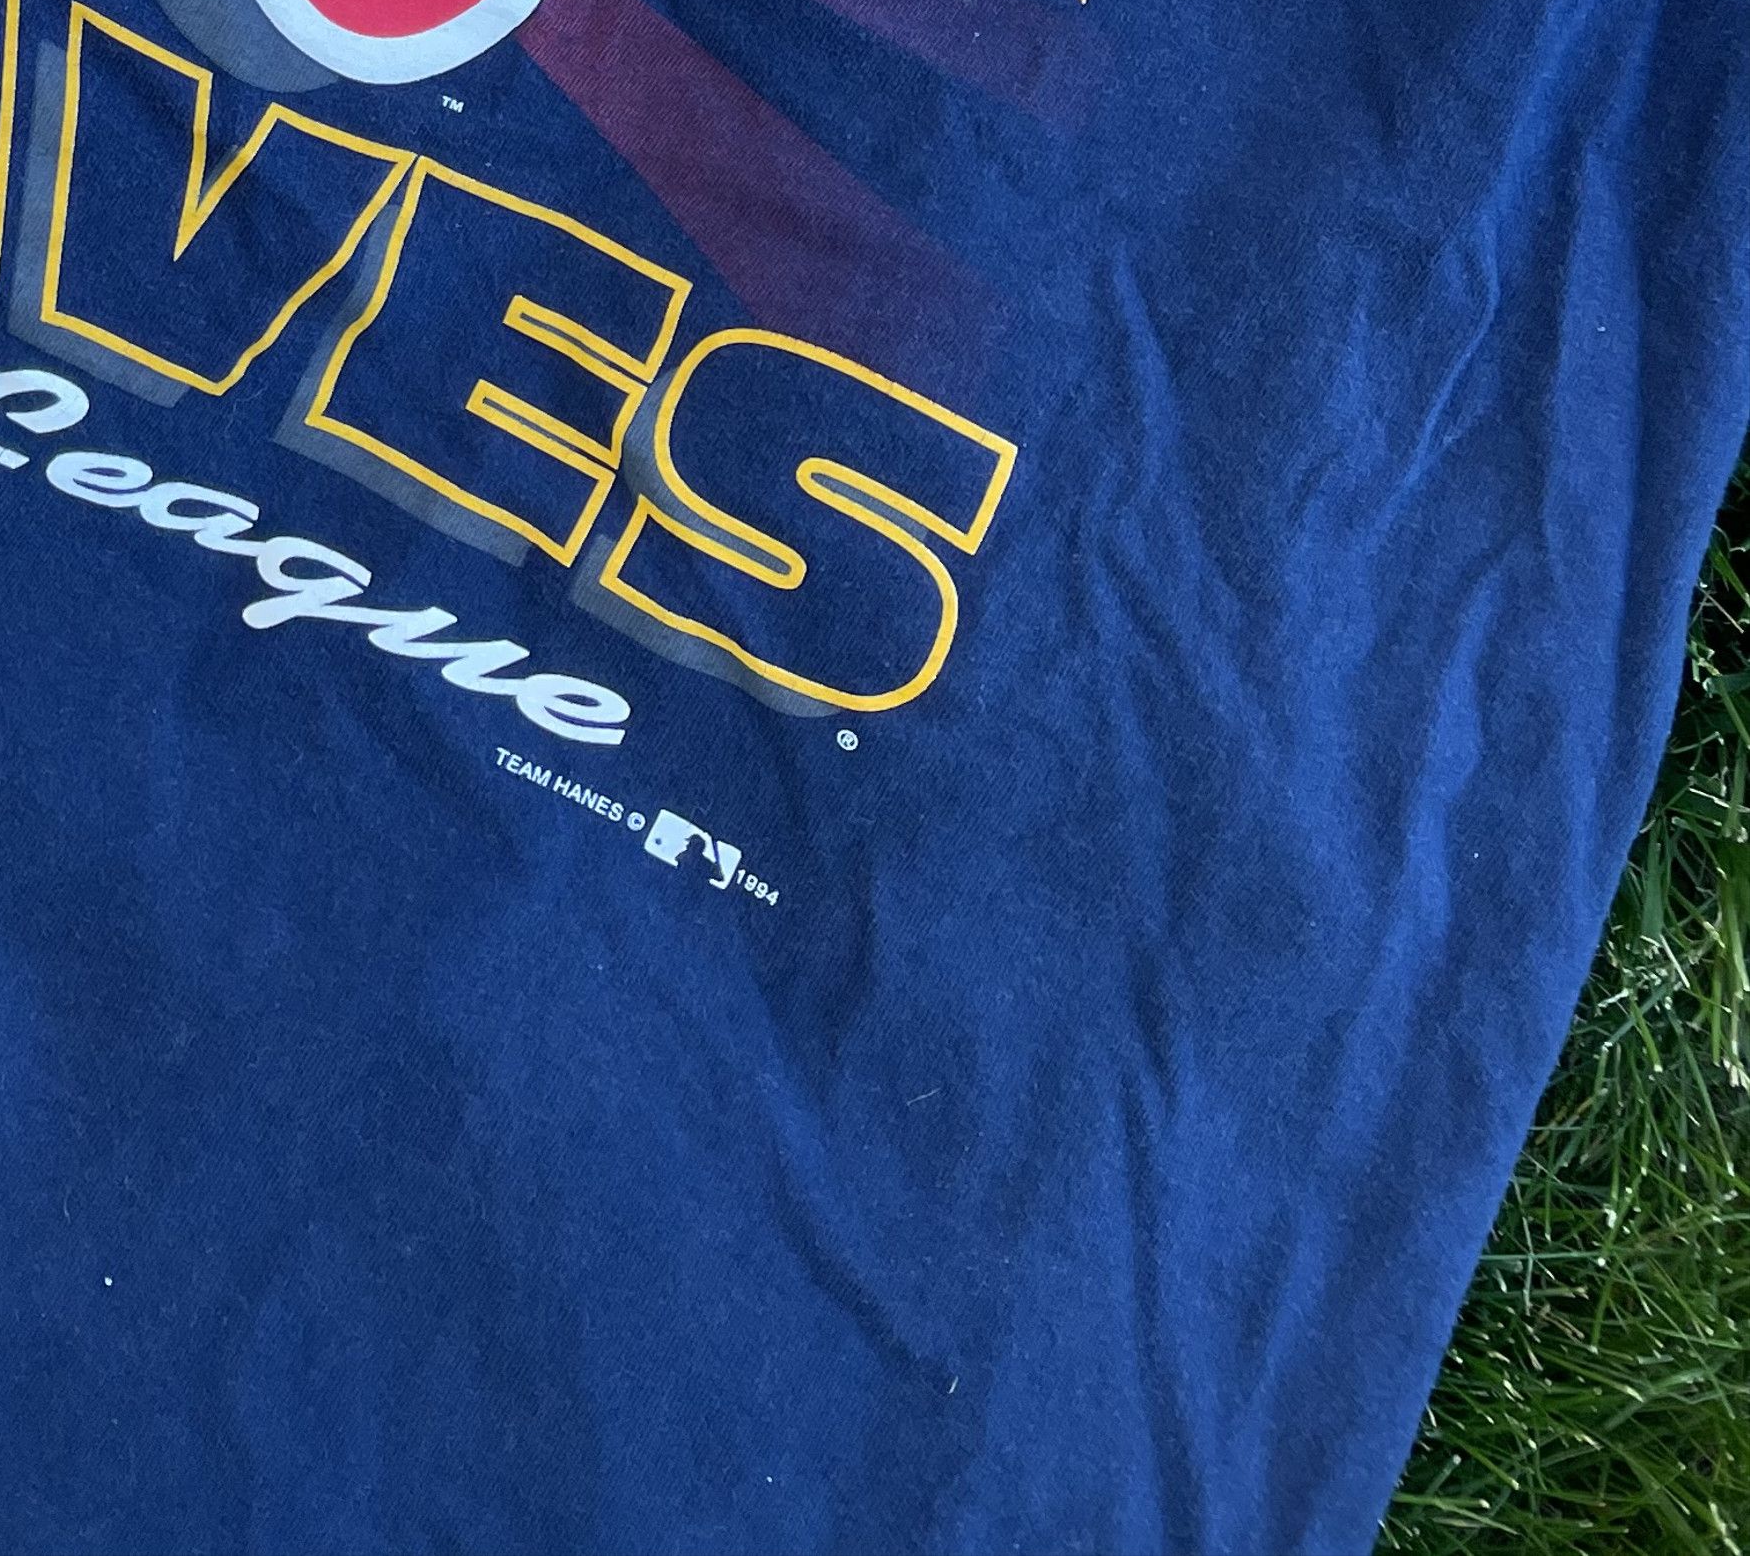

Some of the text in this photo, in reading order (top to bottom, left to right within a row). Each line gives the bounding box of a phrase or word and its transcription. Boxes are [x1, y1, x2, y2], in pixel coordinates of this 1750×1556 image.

[496, 747, 551, 788] TEAM
[552, 776, 623, 823] HANES
[736, 869, 780, 906] 1994
